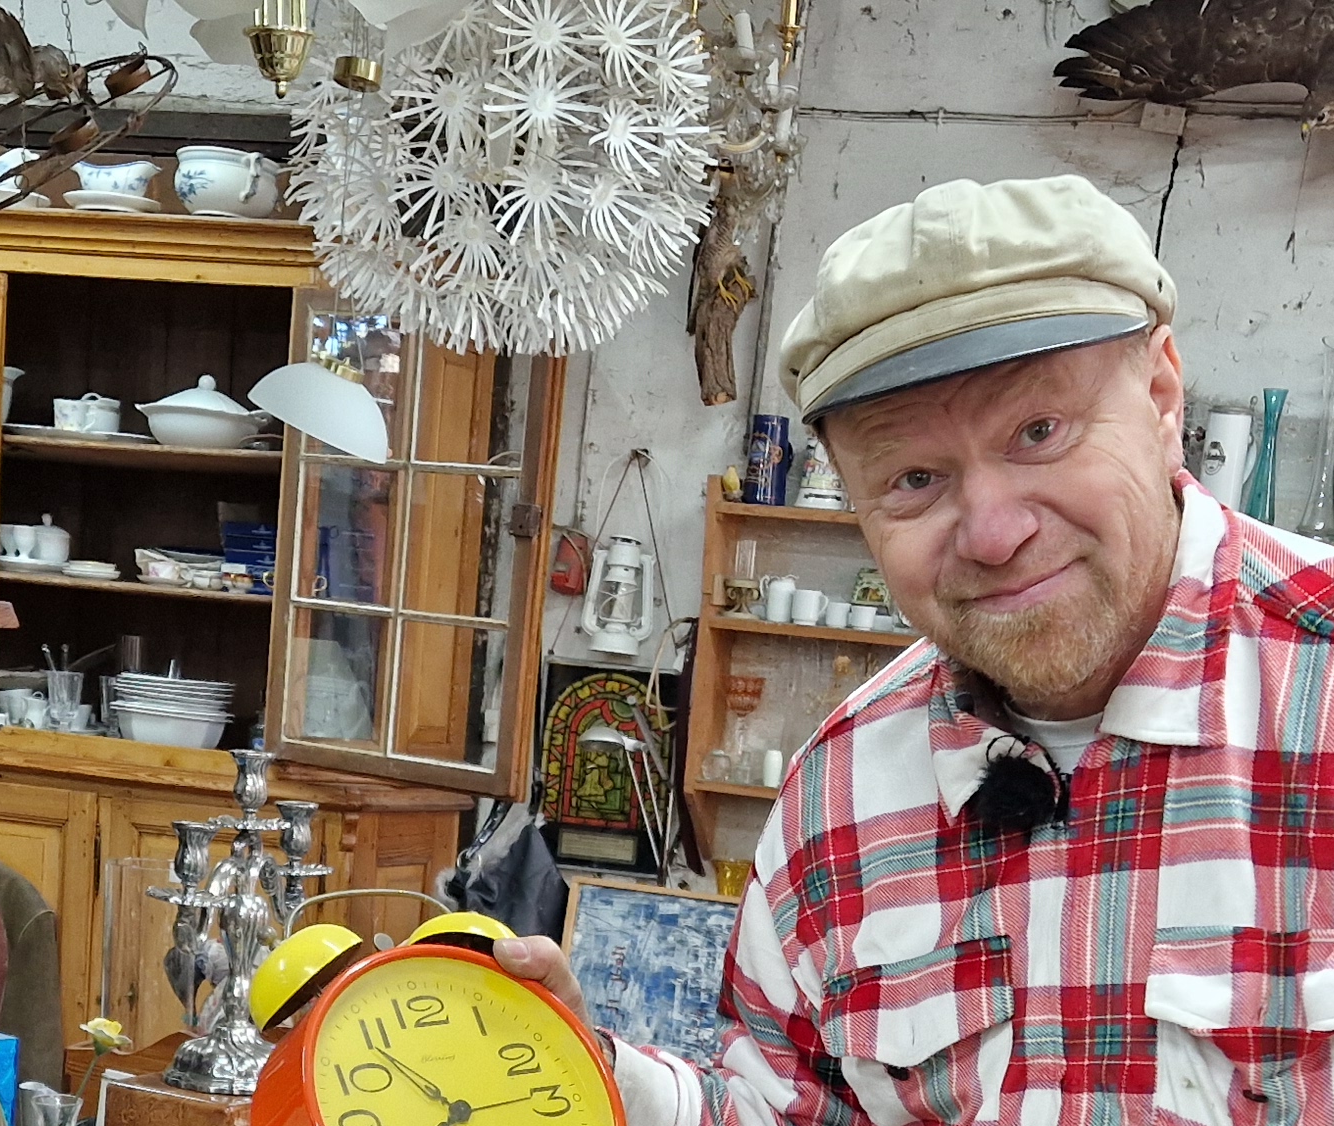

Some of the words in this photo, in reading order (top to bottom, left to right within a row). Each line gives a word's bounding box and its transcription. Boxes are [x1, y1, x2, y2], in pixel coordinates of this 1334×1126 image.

[392, 995, 450, 1029] 12
[472, 1005, 487, 1036] 1
[359, 1017, 391, 1050] 11
[498, 1043, 542, 1077] 2
[334, 1063, 393, 1096] 10
[529, 1084, 572, 1118] 3
